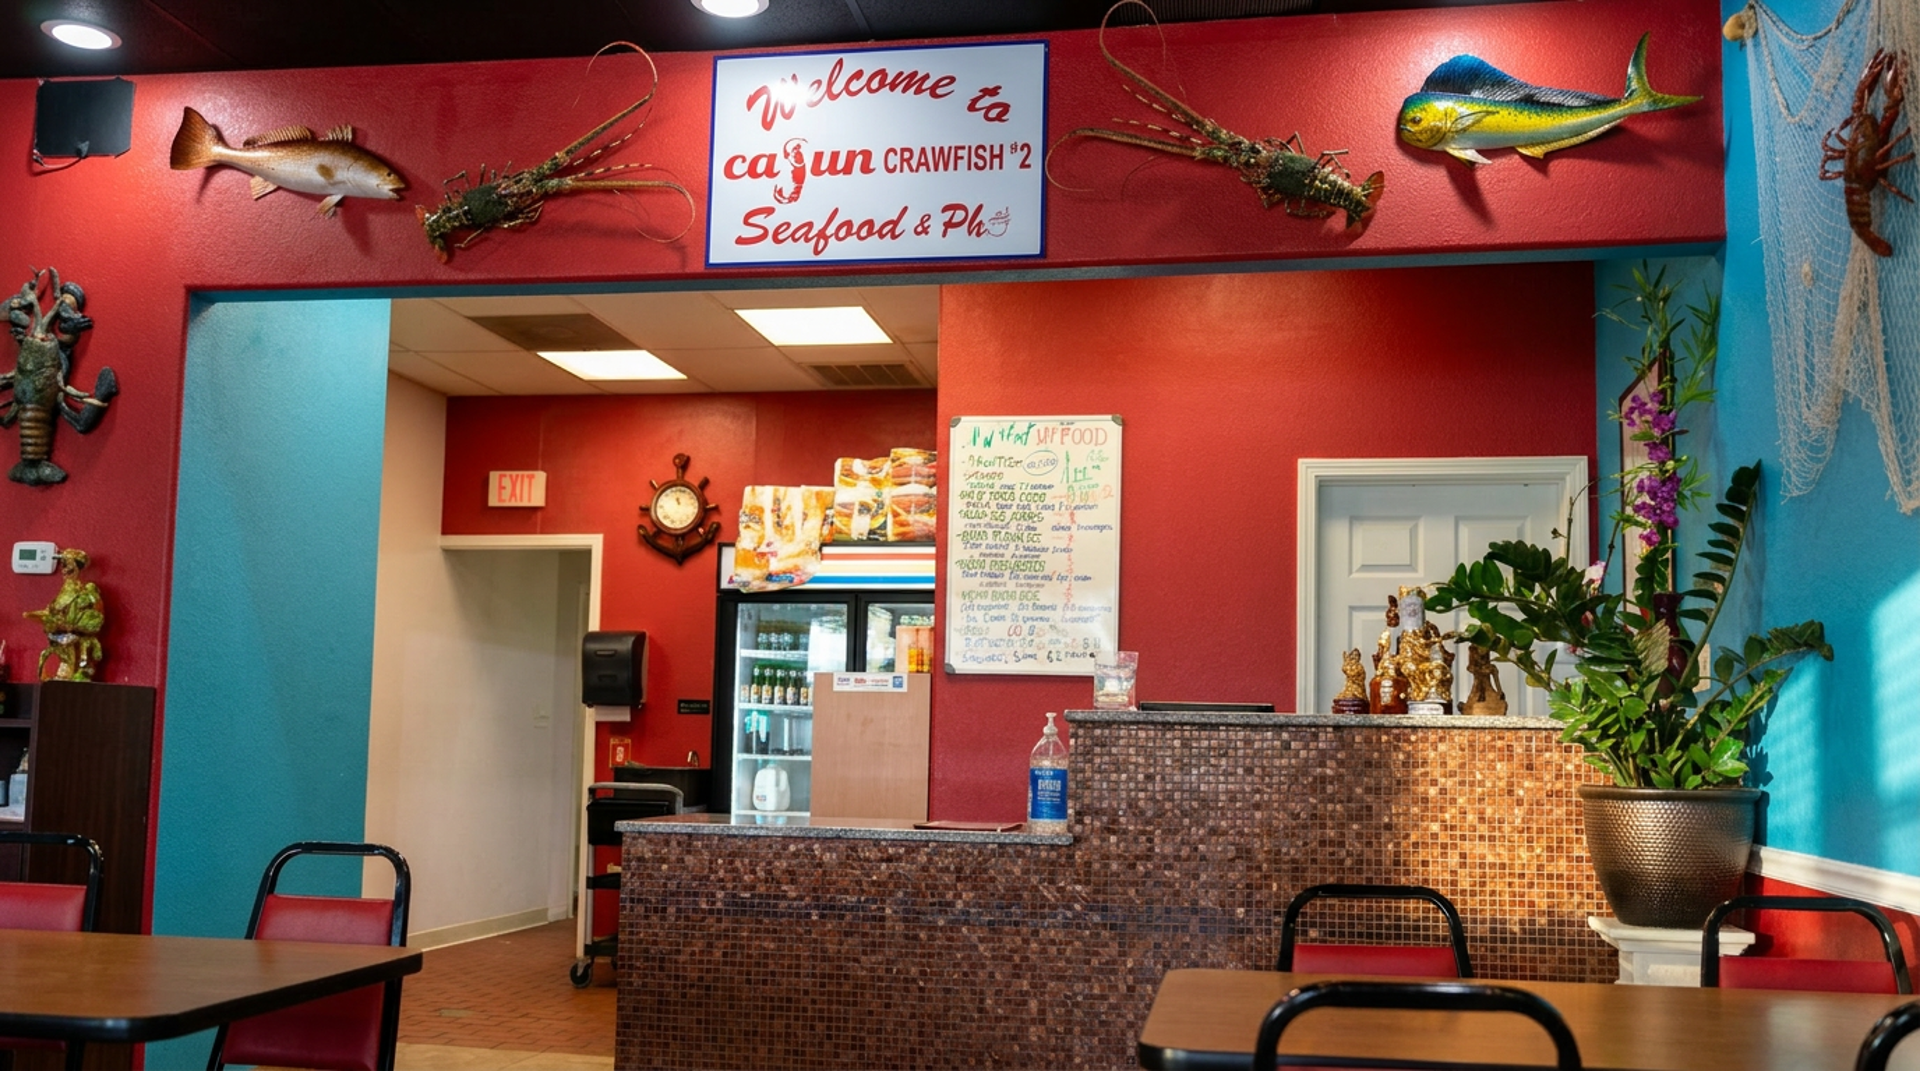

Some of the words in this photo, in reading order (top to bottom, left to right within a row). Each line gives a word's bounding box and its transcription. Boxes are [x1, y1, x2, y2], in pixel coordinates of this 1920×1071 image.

[746, 57, 957, 131] Welcome
[966, 84, 1011, 123] to
[883, 143, 1004, 174] CRAWFISH
[734, 205, 909, 256] Seafood
[913, 213, 931, 236] &
[497, 474, 536, 503] EXIT
